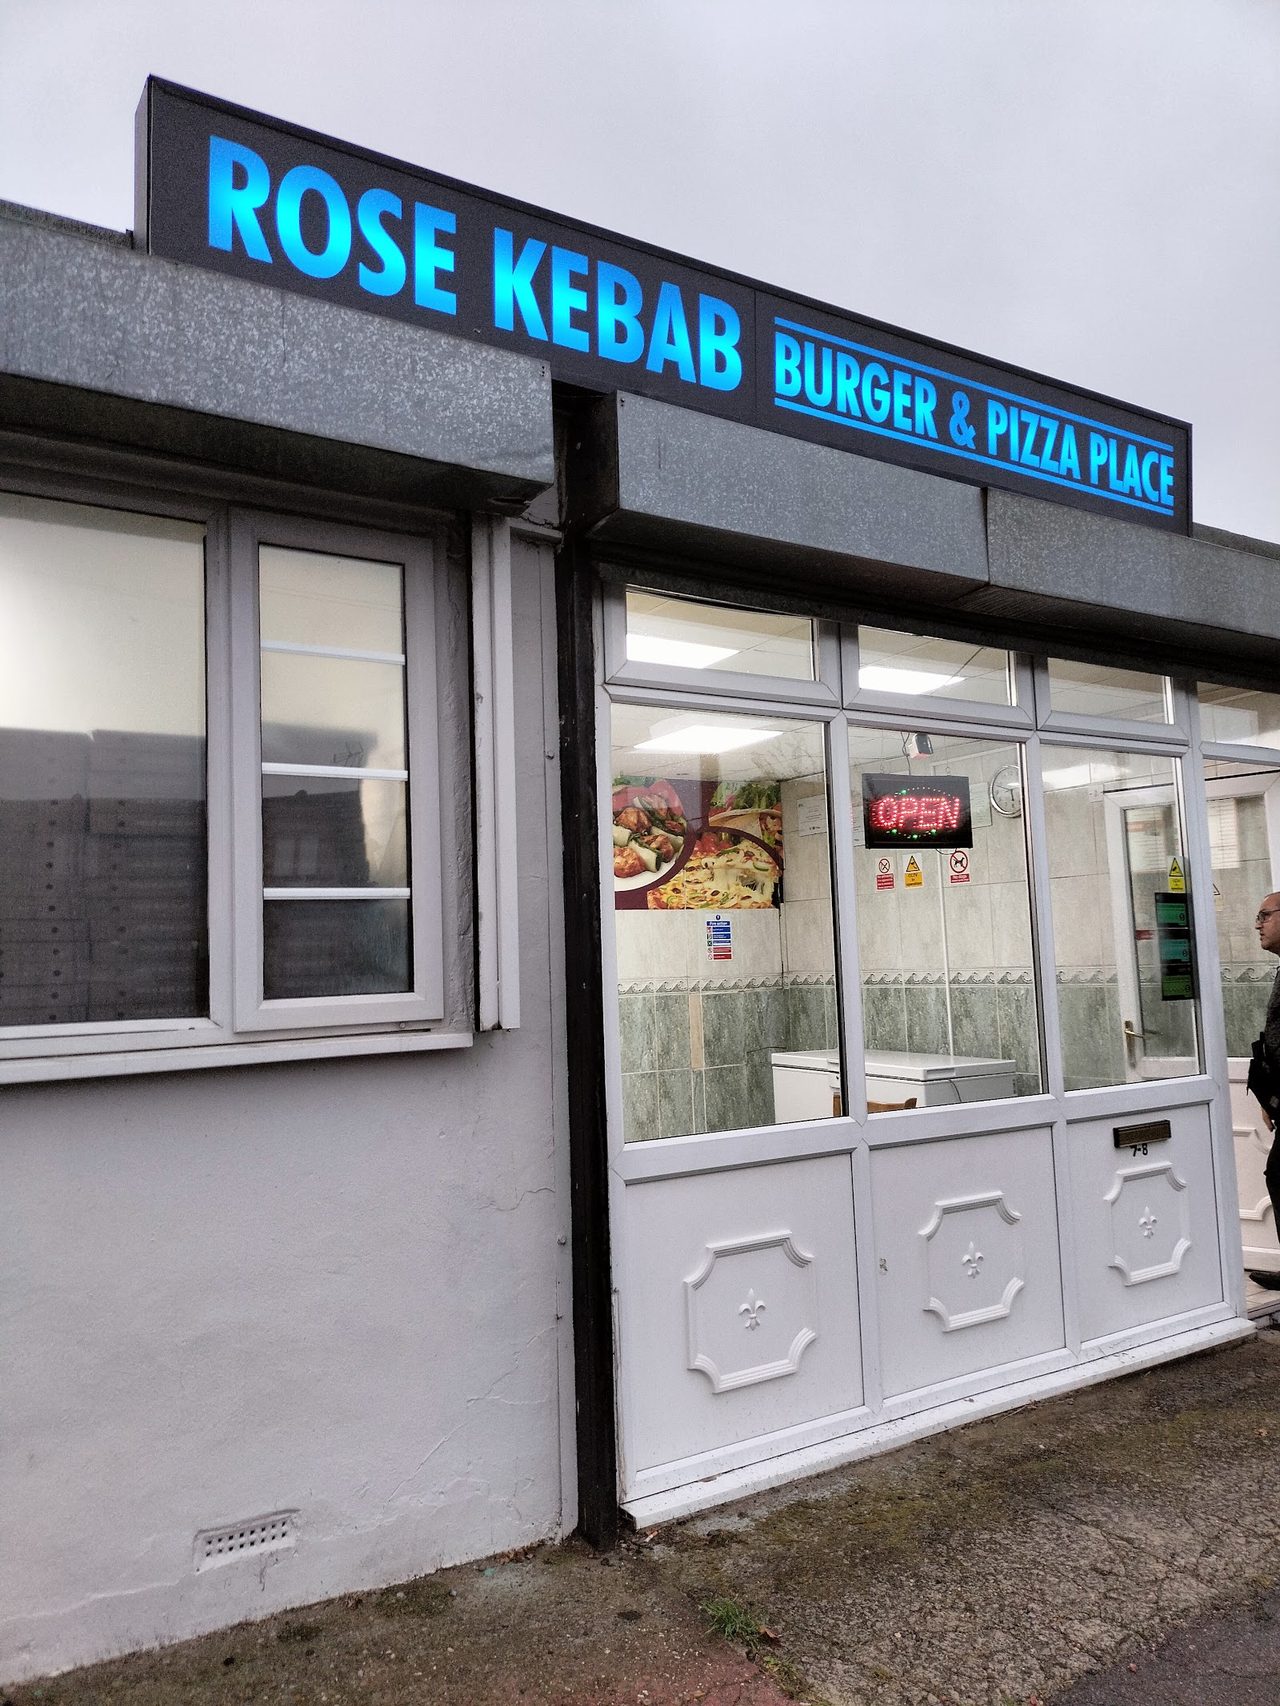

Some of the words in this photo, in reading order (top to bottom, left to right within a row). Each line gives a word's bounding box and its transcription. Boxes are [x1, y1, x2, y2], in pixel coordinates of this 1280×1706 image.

[208, 135, 457, 316] ROSE
[493, 227, 743, 392] KEBAB
[774, 331, 938, 439] BURGER
[949, 391, 976, 449] &
[987, 399, 1081, 480] PIZZA
[1089, 431, 1175, 506] PLACE
[877, 796, 960, 829] OPEN
[1130, 1143, 1148, 1157] 7-8
